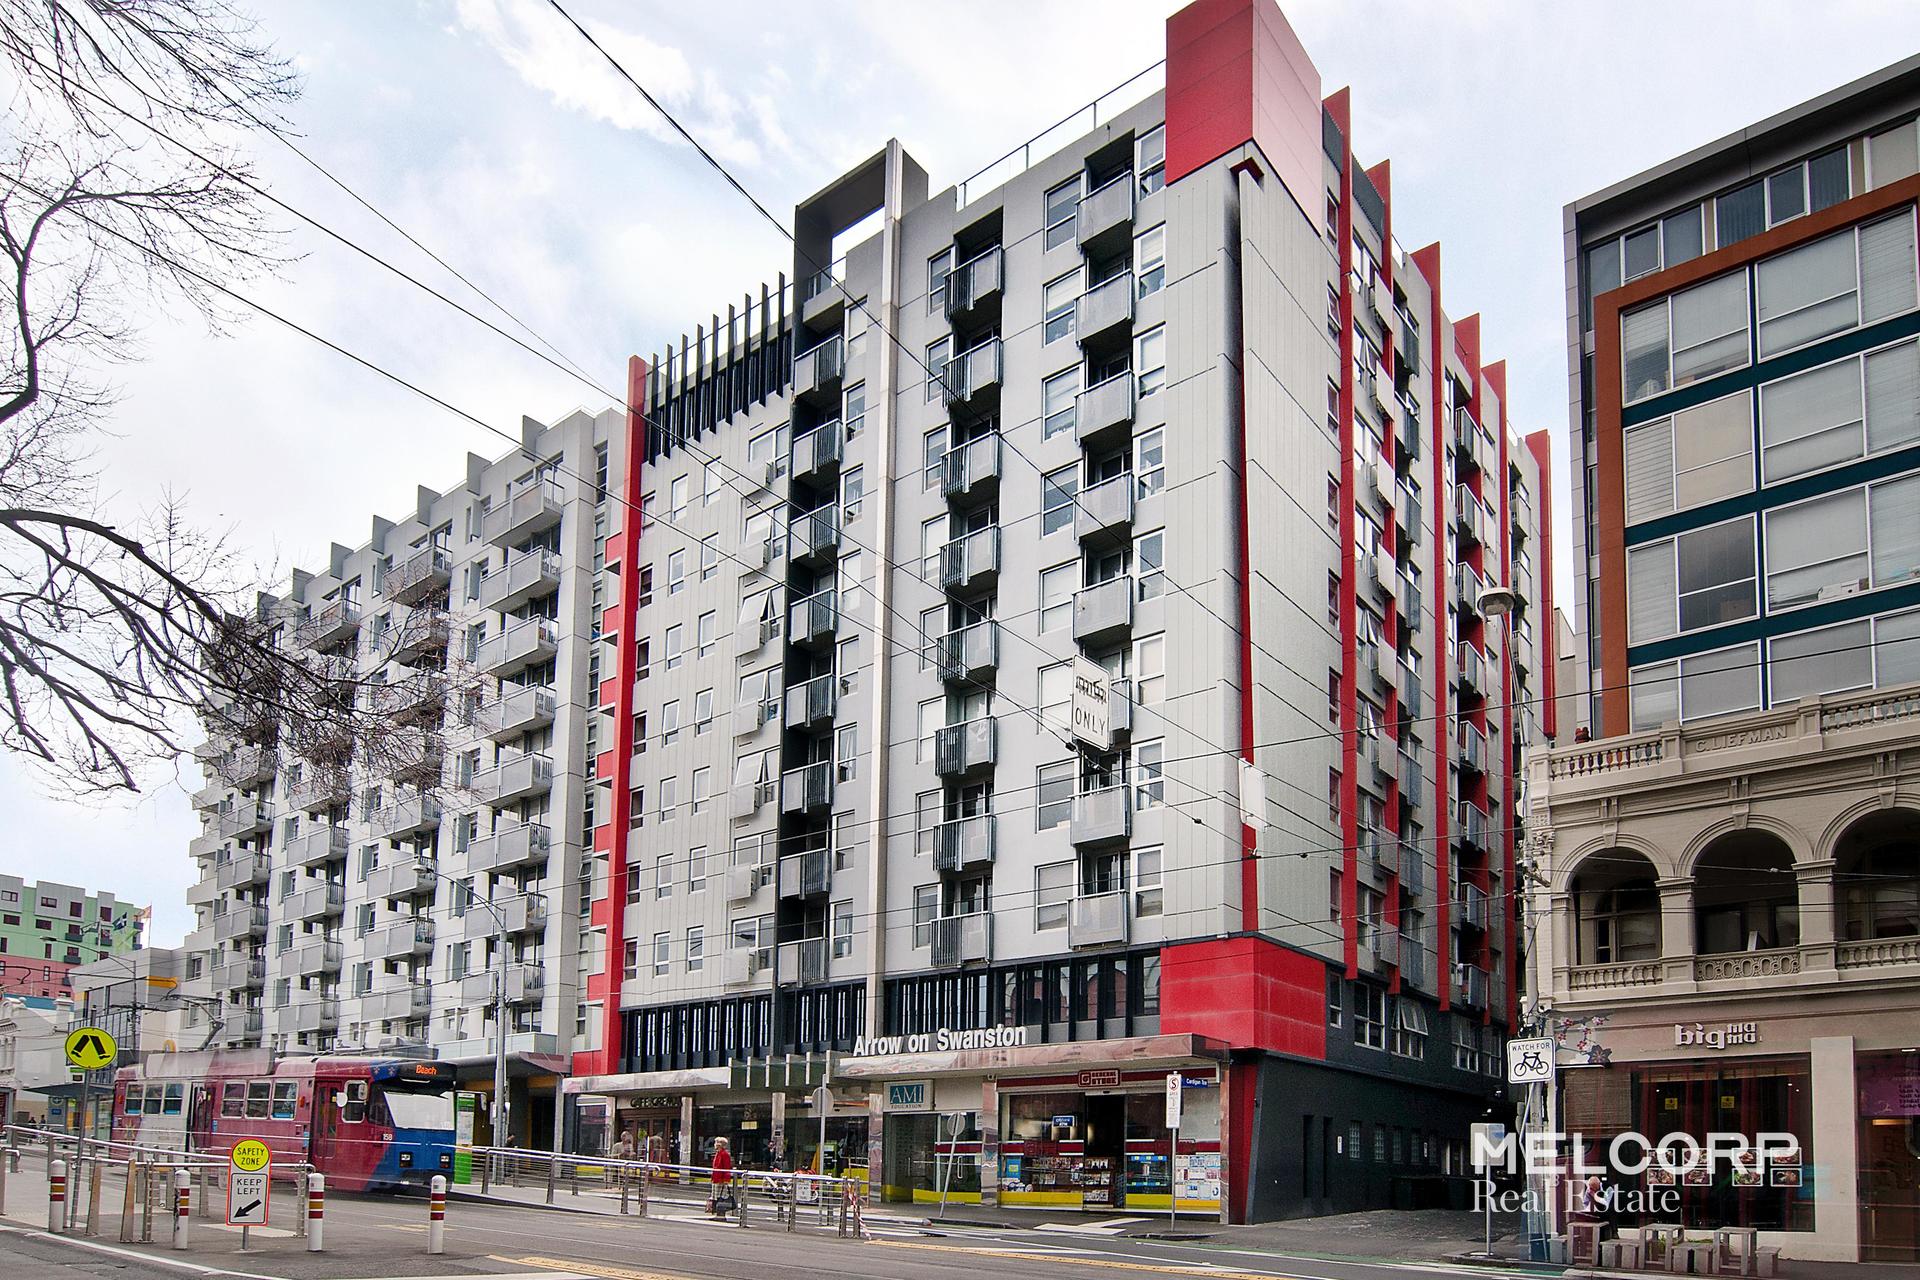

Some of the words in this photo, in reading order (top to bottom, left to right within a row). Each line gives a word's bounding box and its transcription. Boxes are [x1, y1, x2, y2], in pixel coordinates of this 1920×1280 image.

[1075, 707, 1106, 736] ONLY
[853, 1035, 902, 1057] Arrow
[908, 1033, 930, 1052] on
[937, 1024, 1028, 1050] Swanston
[1675, 1023, 1725, 1049] big
[1512, 1043, 1535, 1051] WATCH
[1536, 1042, 1551, 1050] FOR
[415, 1065, 437, 1075] Beach
[890, 1086, 922, 1103] AMI
[237, 1147, 265, 1156] SAFETY
[241, 1157, 260, 1166] ZONE
[237, 1178, 262, 1186] KEEP
[237, 1187, 261, 1195] LEFT
